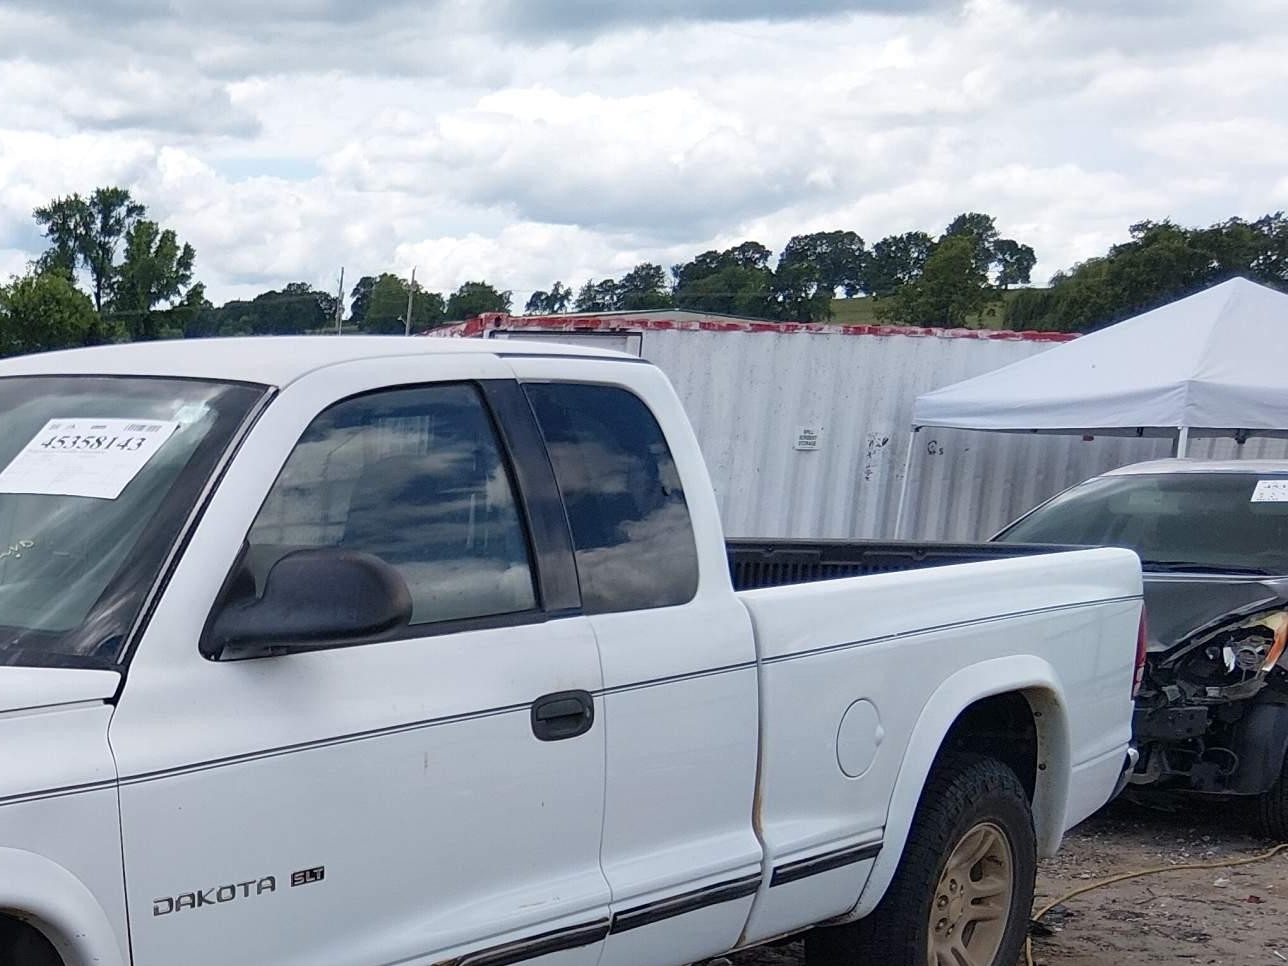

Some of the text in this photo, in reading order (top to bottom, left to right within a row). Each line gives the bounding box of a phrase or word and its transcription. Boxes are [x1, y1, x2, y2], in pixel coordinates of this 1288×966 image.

[41, 435, 147, 451] 45358143
[152, 867, 324, 917] DAKOTA SLT
